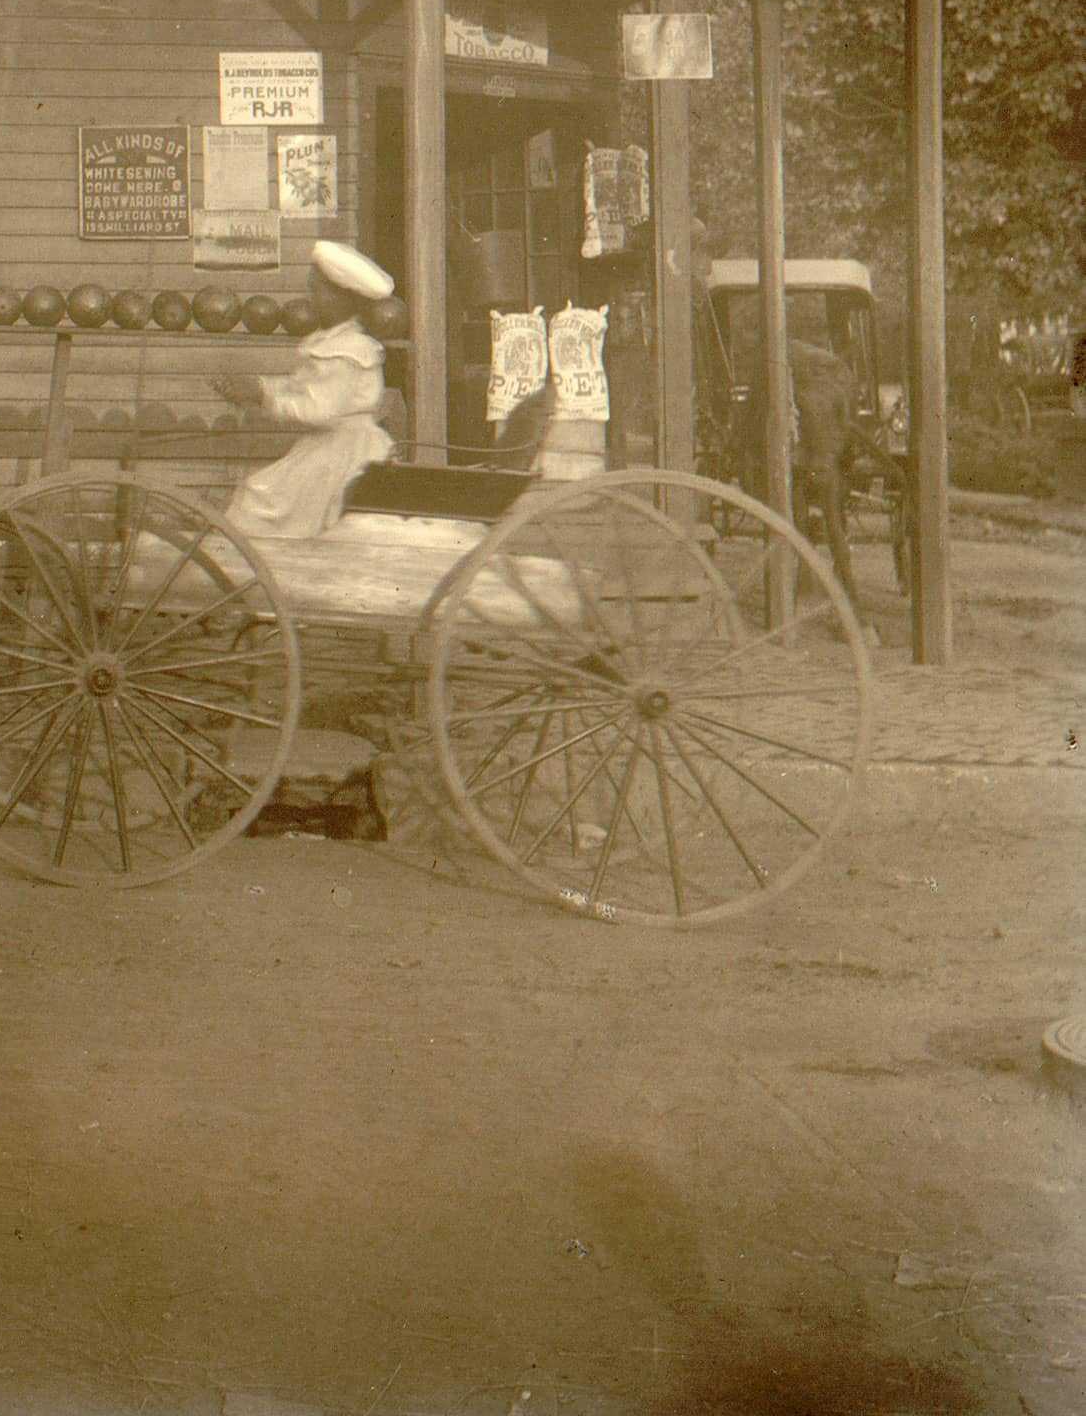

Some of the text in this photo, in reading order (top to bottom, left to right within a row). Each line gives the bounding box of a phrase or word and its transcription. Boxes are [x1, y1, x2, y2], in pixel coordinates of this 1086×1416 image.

[454, 31, 535, 62] TOBACCO
[230, 86, 310, 99] PREMIUM
[85, 134, 186, 161] ALL KINDS OF
[85, 166, 177, 180] WHITE SEWING
[86, 181, 120, 193] DONE
[84, 194, 187, 209] BABY WARDROBE
